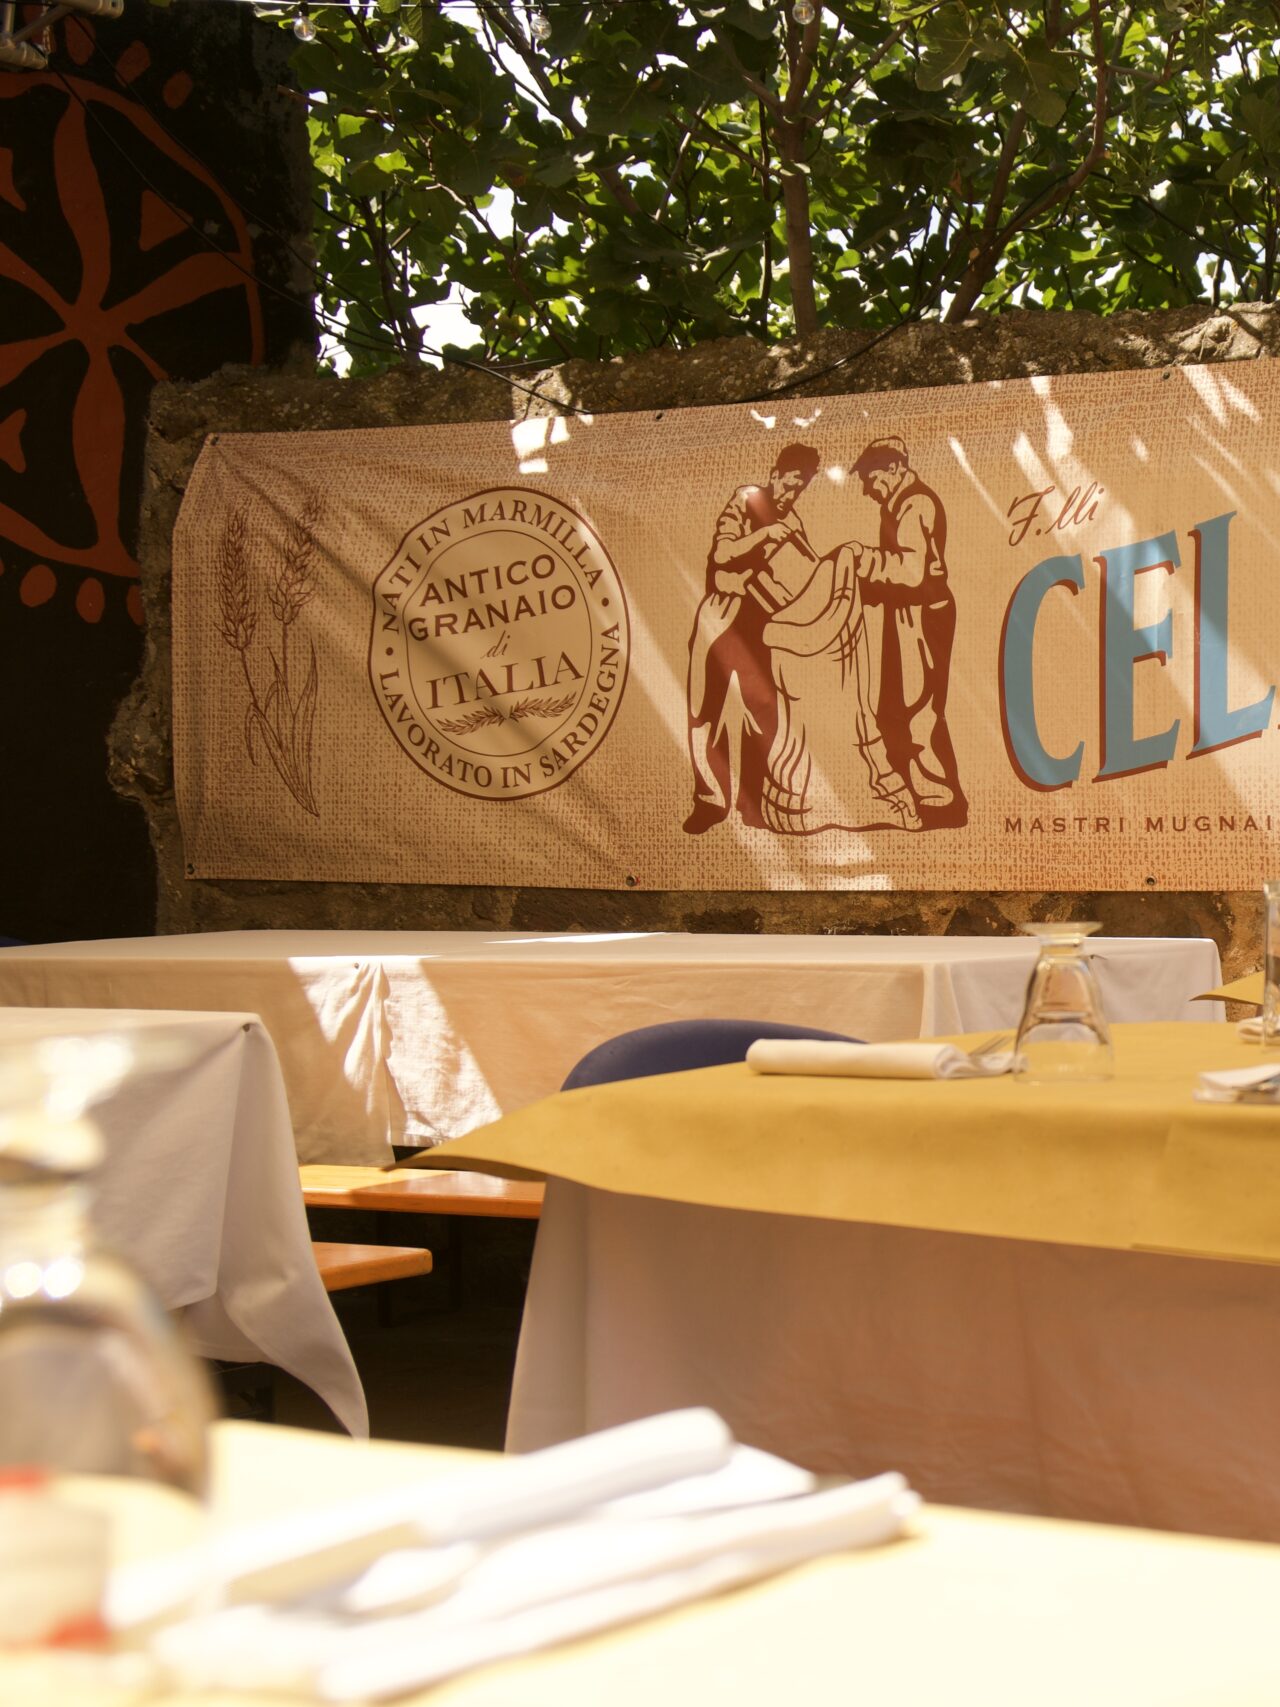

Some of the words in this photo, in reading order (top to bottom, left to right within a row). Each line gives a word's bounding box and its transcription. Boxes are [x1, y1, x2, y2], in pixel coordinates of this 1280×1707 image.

[382, 554, 422, 634] NATI
[416, 519, 452, 555] IN
[462, 499, 604, 590] MARMILLA
[419, 554, 556, 607] ANTICO
[408, 585, 576, 641] GRANAIO
[480, 630, 511, 660] di
[379, 667, 493, 788] LAVORATO
[501, 763, 532, 788] IN
[539, 621, 621, 777] SARDEGNA
[426, 651, 584, 710] ITALIA
[1004, 815, 1126, 833] MASTRI
[1145, 815, 1274, 833] MUGNAI
